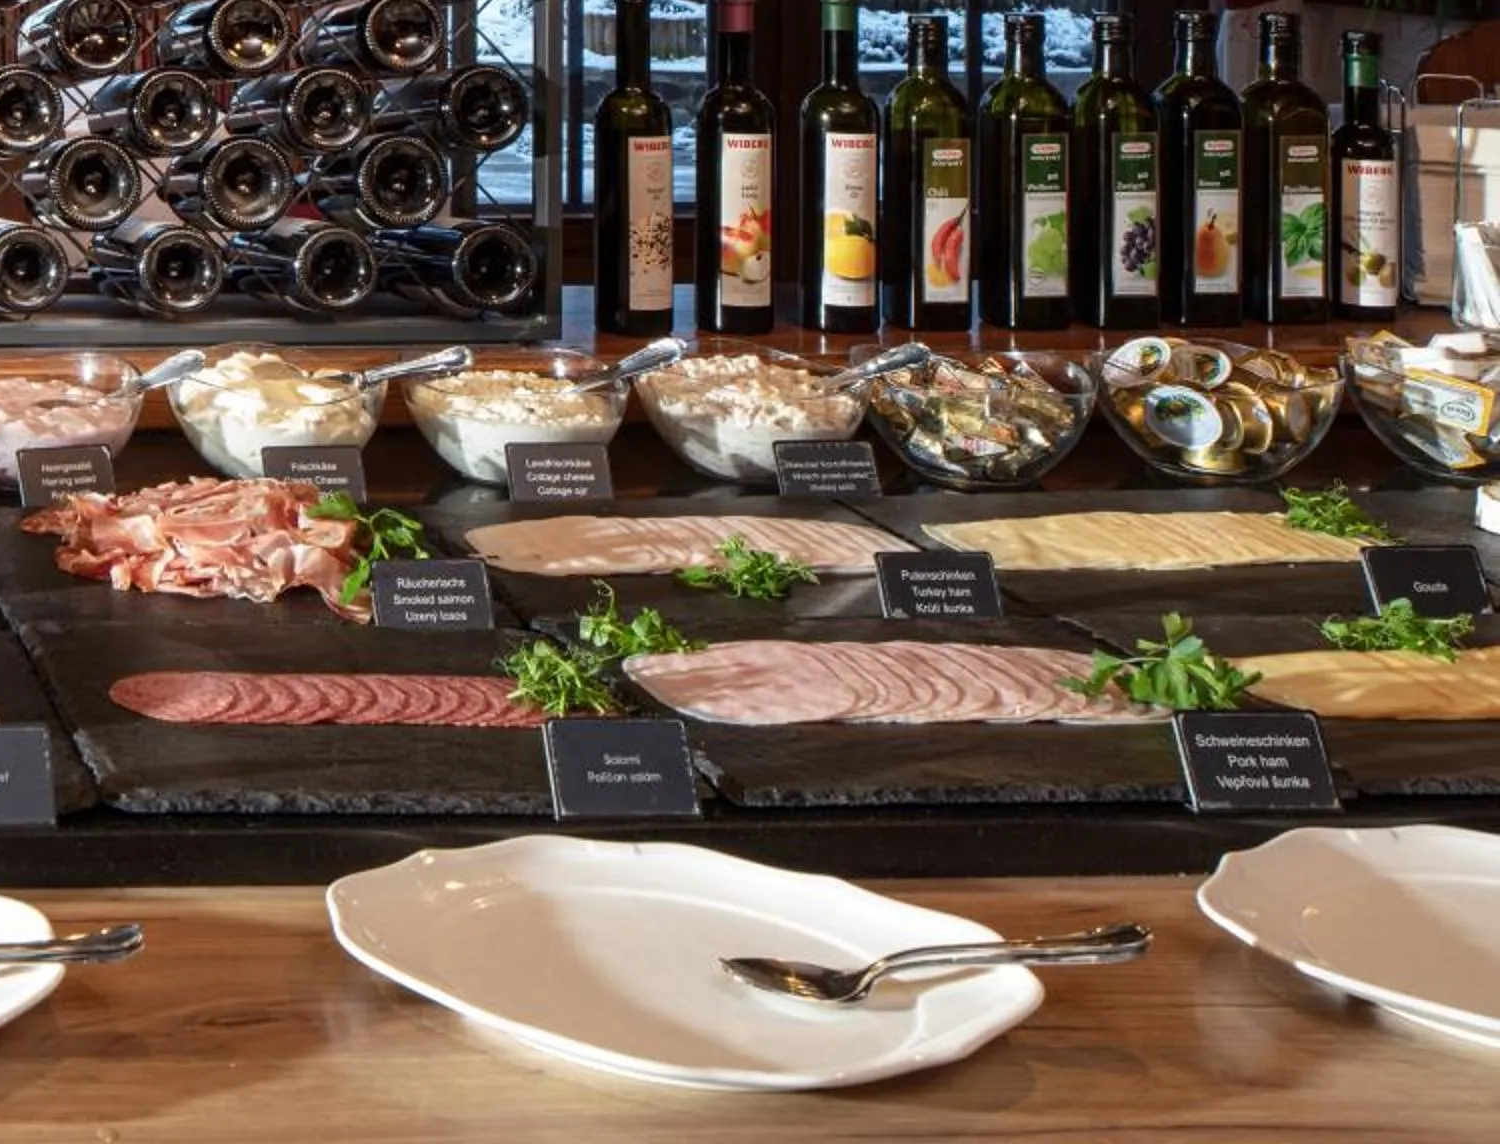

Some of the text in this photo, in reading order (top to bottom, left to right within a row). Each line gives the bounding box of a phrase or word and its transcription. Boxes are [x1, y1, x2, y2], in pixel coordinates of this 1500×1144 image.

[911, 585, 972, 599] Turkey ham
[1413, 581, 1449, 593] Gouda
[393, 593, 475, 605] Smoked salmon
[1195, 733, 1311, 748] Schweineschinken
[1227, 755, 1289, 769] Pork ham
[1216, 775, 1312, 791] Vepřová šunka
